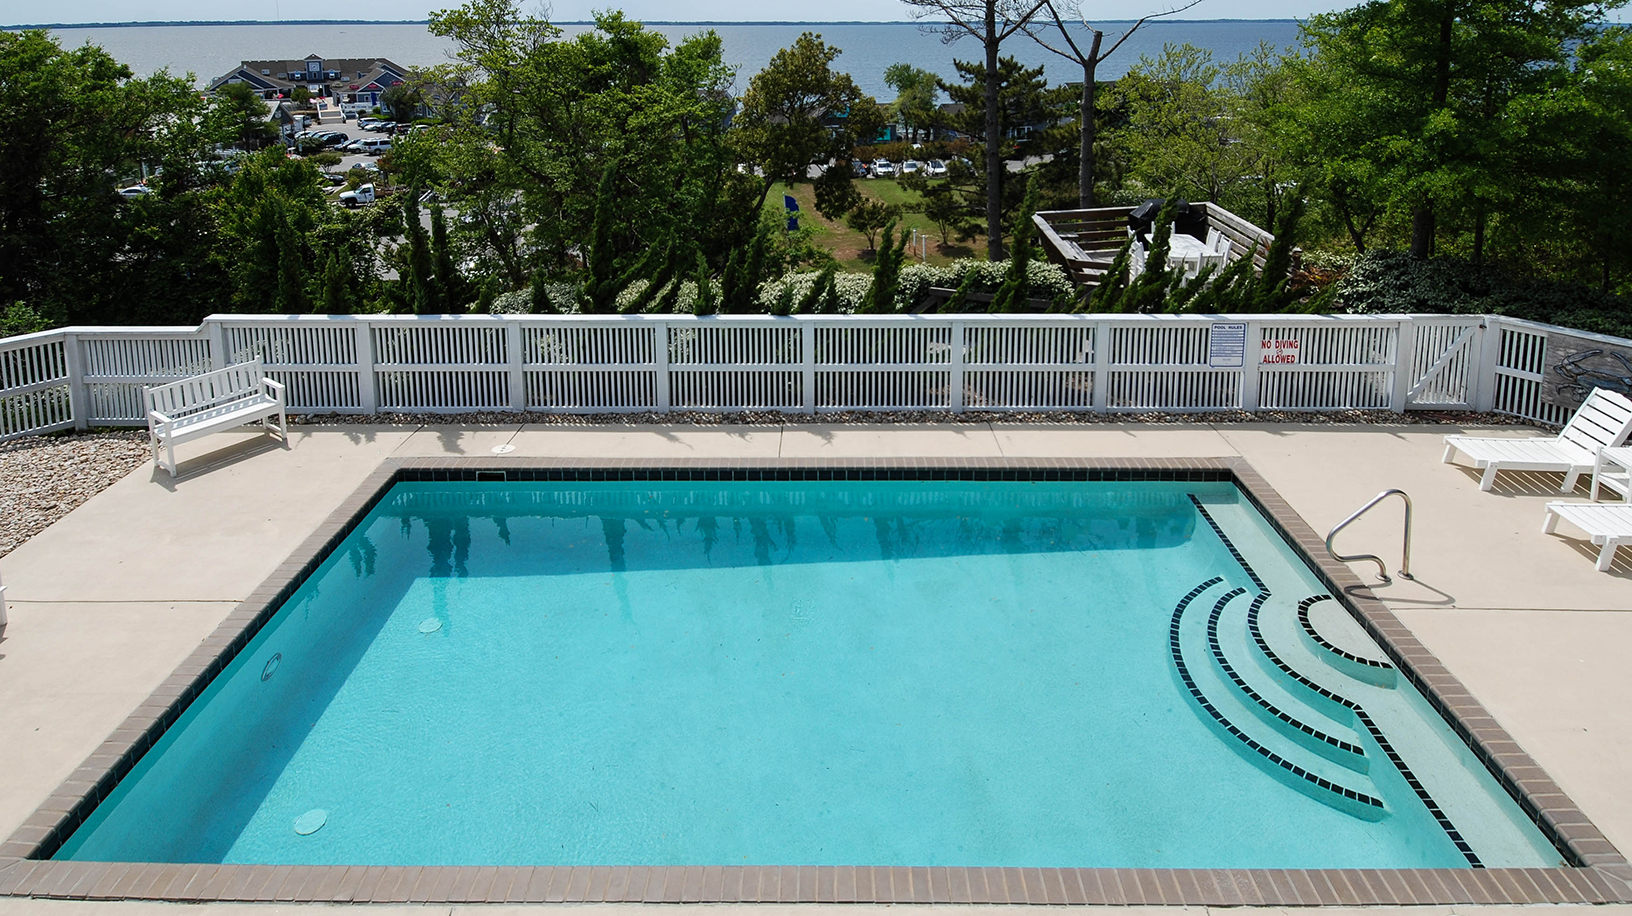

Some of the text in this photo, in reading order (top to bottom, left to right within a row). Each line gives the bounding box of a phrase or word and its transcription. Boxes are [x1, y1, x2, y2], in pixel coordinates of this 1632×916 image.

[1261, 340, 1298, 349] NO DIVING
[1262, 355, 1296, 364] ALLOWED
